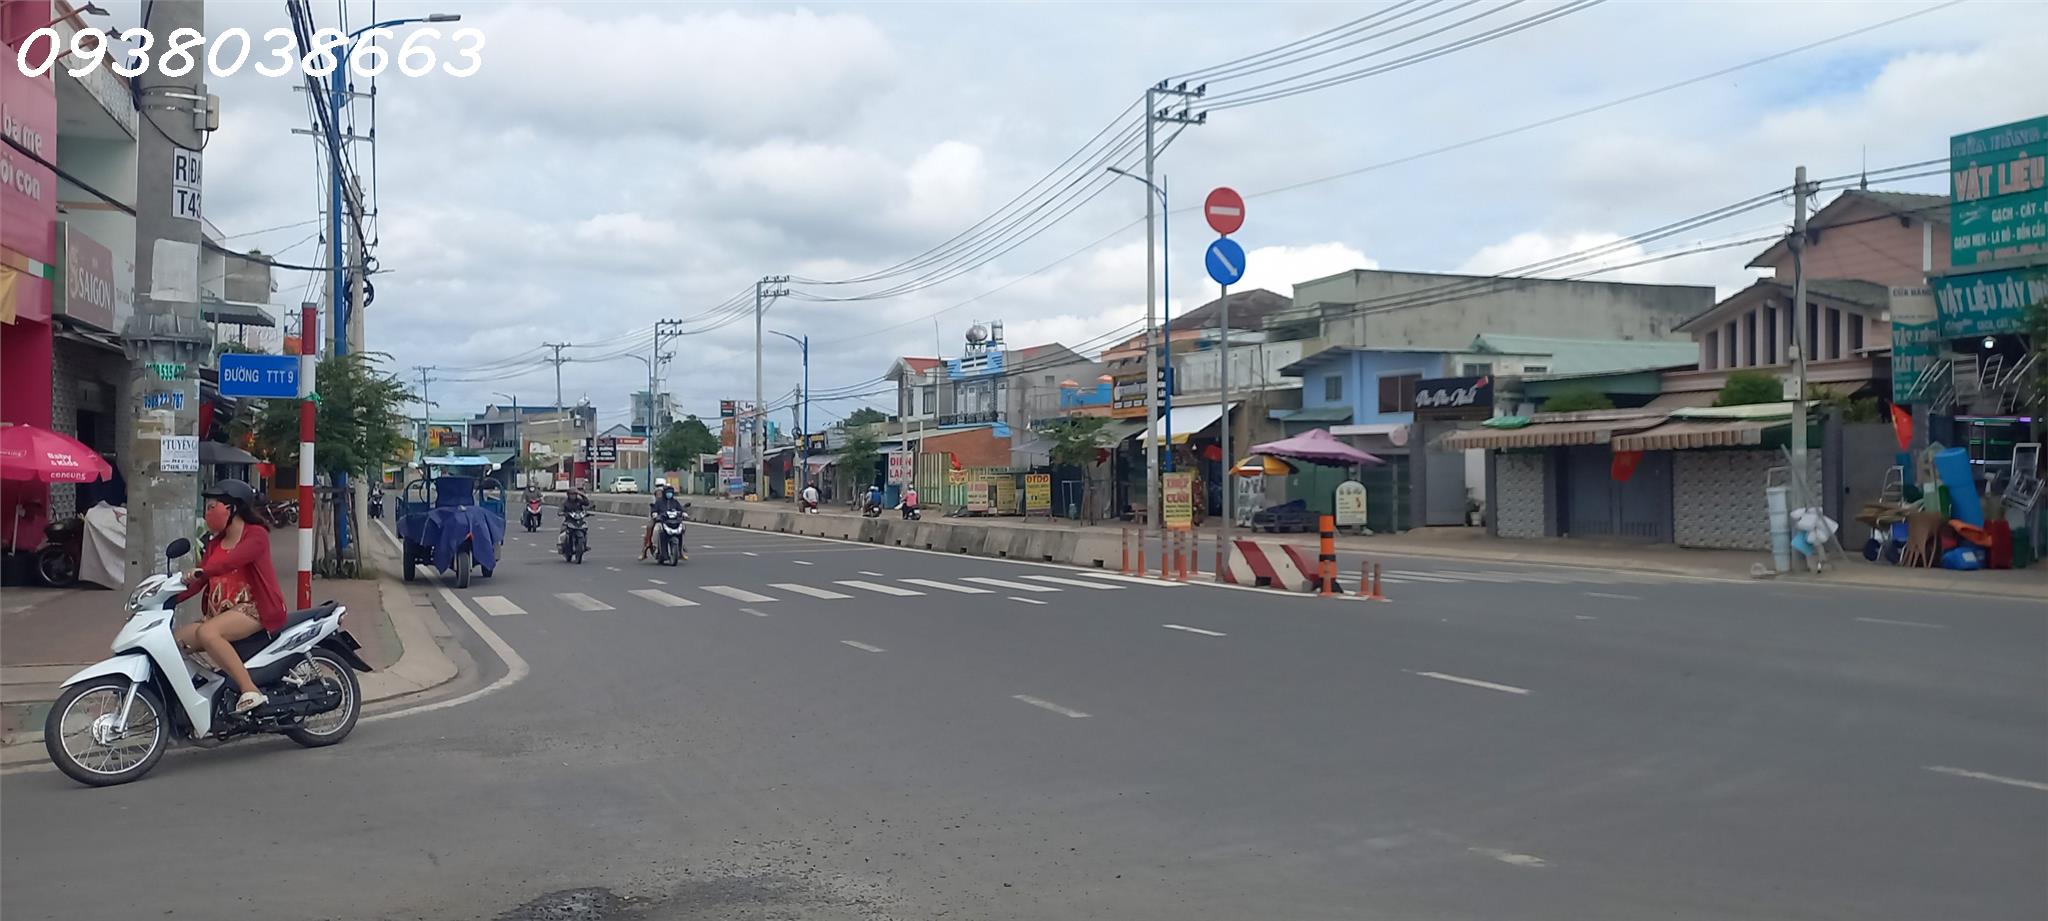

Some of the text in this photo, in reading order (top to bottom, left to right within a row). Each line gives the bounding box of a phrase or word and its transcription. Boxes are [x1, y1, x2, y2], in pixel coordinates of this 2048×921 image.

[176, 155, 187, 181] R
[79, 266, 112, 312] SAIGON
[1997, 275, 2026, 310] XÂY
[224, 365, 294, 384] ĐƯỜNG TTT 9
